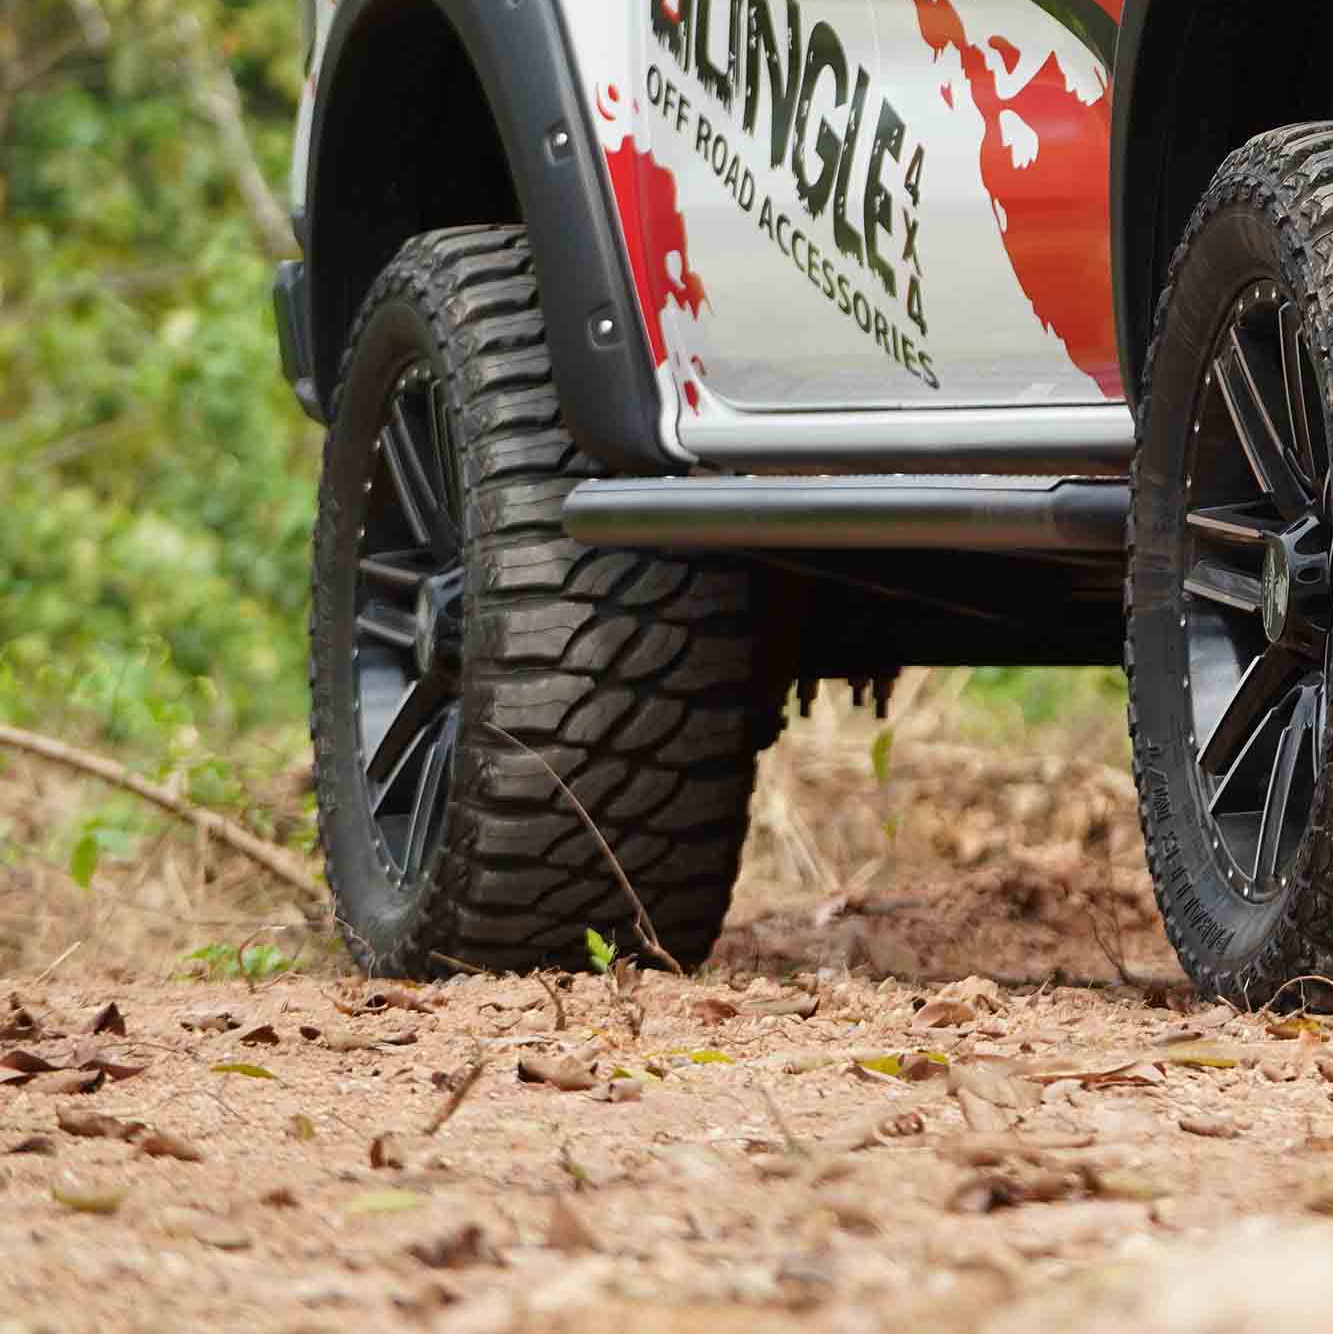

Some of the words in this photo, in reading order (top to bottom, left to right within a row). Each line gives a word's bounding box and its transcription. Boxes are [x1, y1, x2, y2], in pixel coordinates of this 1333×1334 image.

[646, 65, 690, 130] OFF
[696, 112, 755, 213] ROAD
[758, 196, 940, 390] ACCESSORIES
